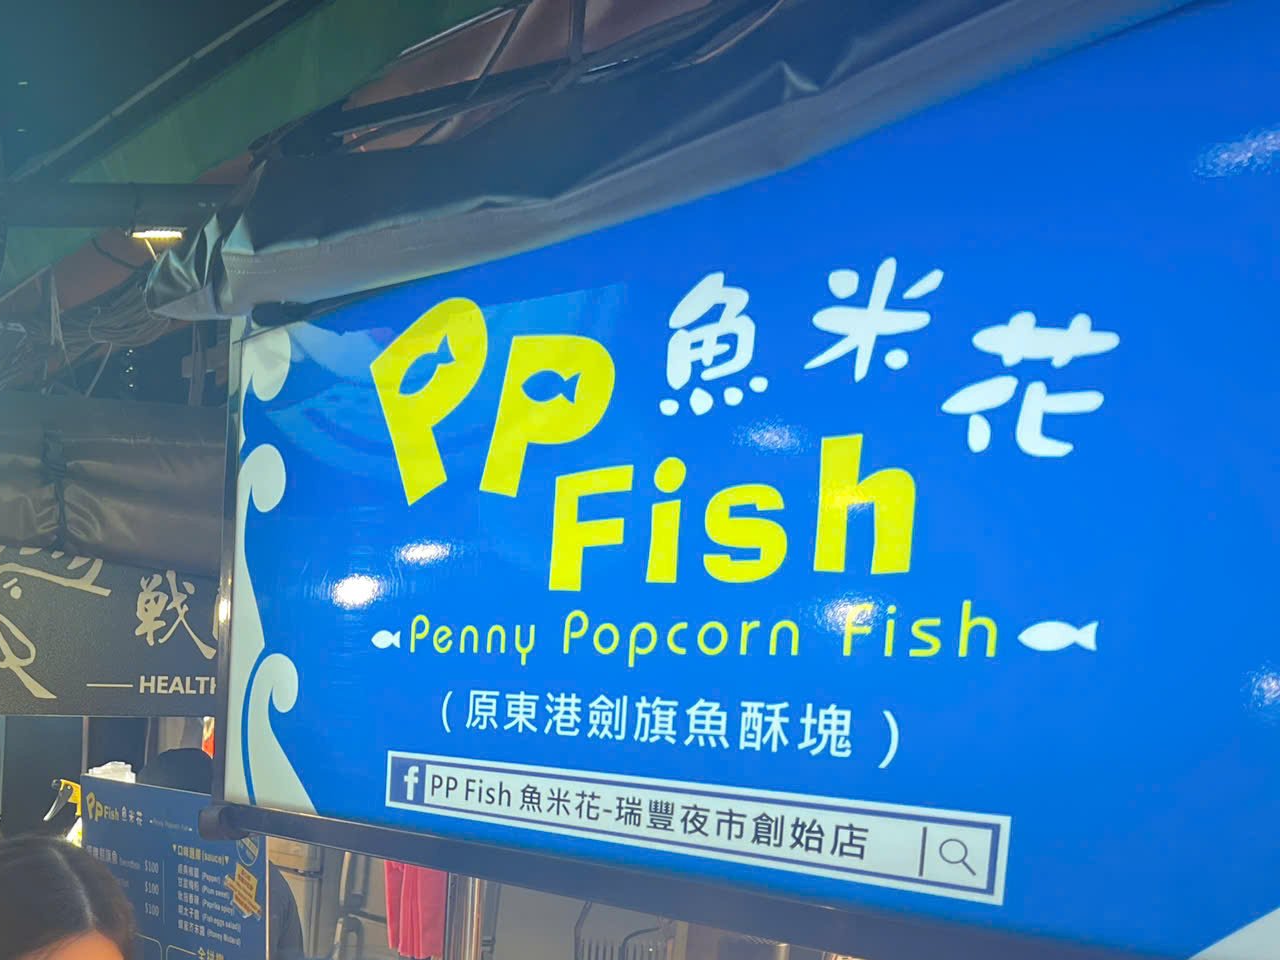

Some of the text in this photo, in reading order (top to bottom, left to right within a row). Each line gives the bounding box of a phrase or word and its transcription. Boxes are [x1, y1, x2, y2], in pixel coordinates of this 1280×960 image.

[370, 296, 615, 505] PP
[659, 256, 1120, 457] 魚米花
[547, 433, 916, 591] Fish
[410, 614, 536, 666] Penny
[563, 610, 800, 668] Popcorn
[431, 773, 869, 861] PP Fish 魚米花-瑞豐夜市創始店
